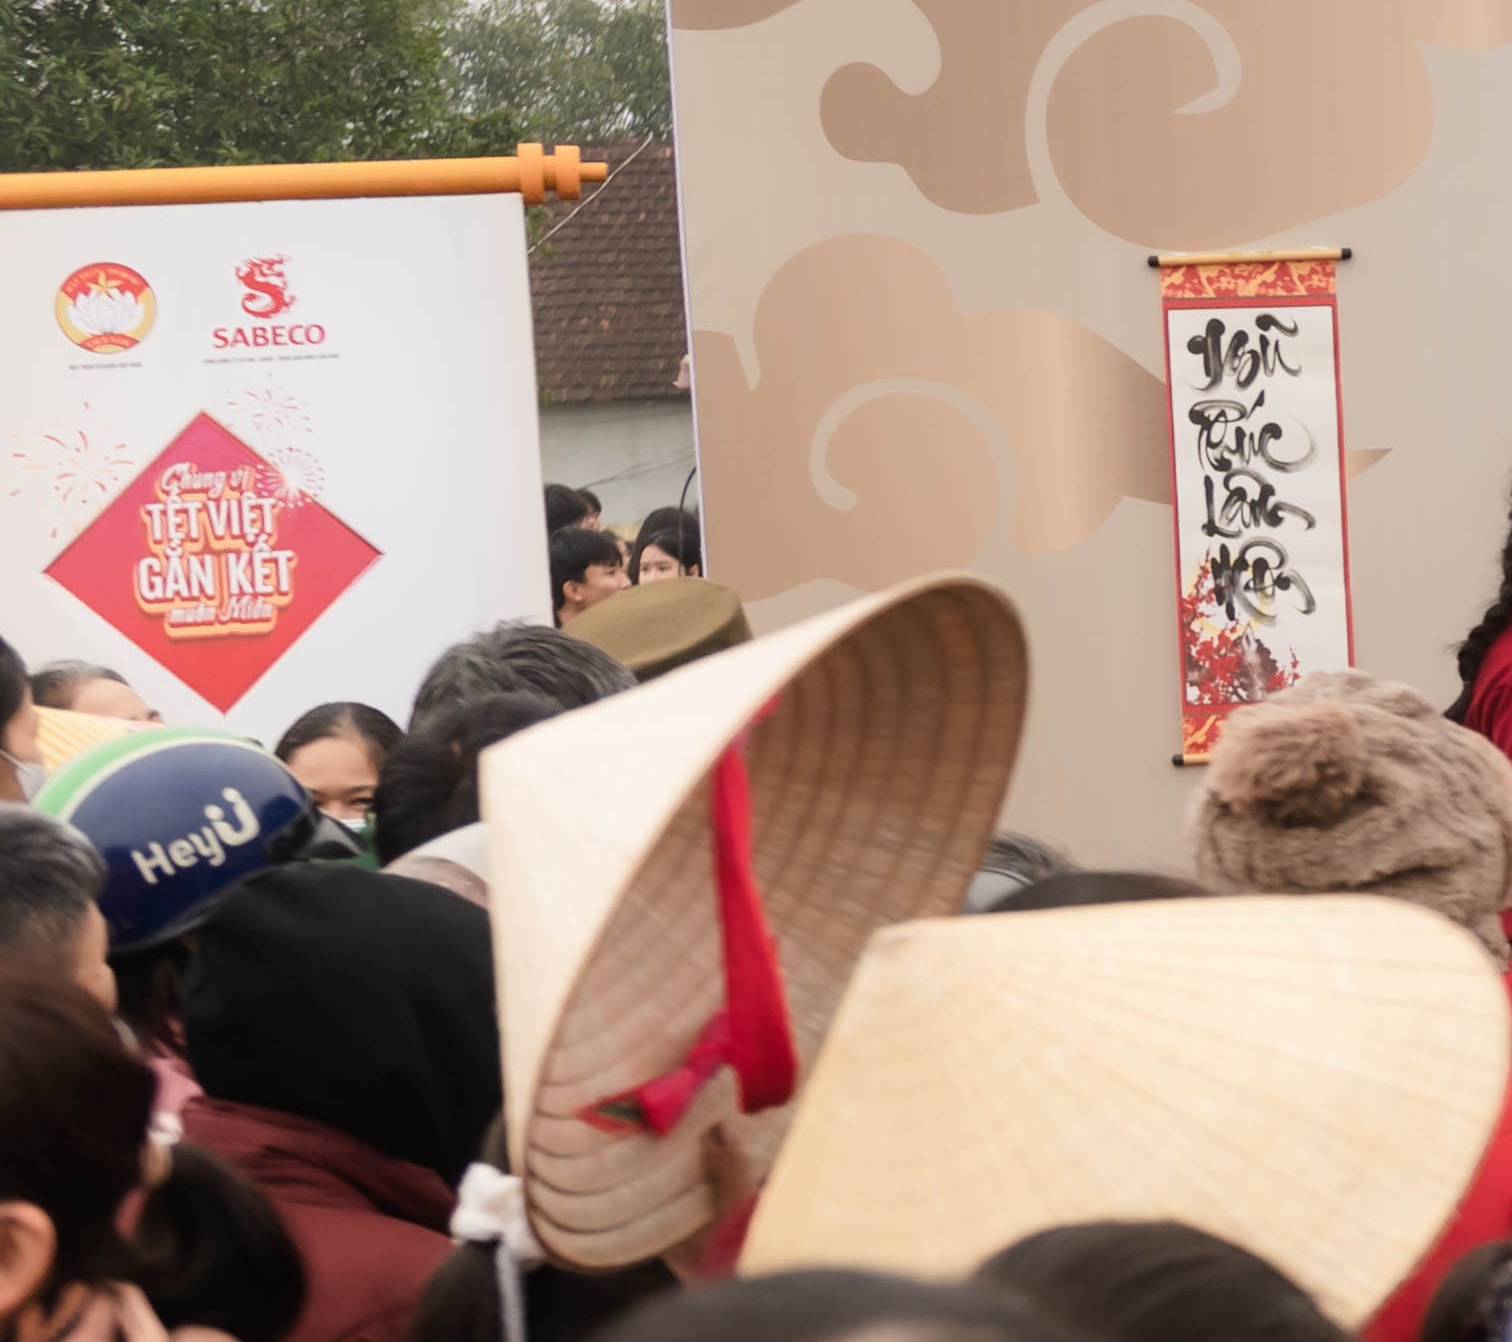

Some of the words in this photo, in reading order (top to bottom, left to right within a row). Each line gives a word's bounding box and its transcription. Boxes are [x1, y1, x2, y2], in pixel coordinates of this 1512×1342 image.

[212, 324, 326, 349] SABECO
[161, 462, 225, 498] Chung
[145, 488, 203, 540] TẾT
[206, 491, 276, 543] VIỆT
[138, 538, 216, 600] GẮN
[227, 533, 295, 595] KẾT
